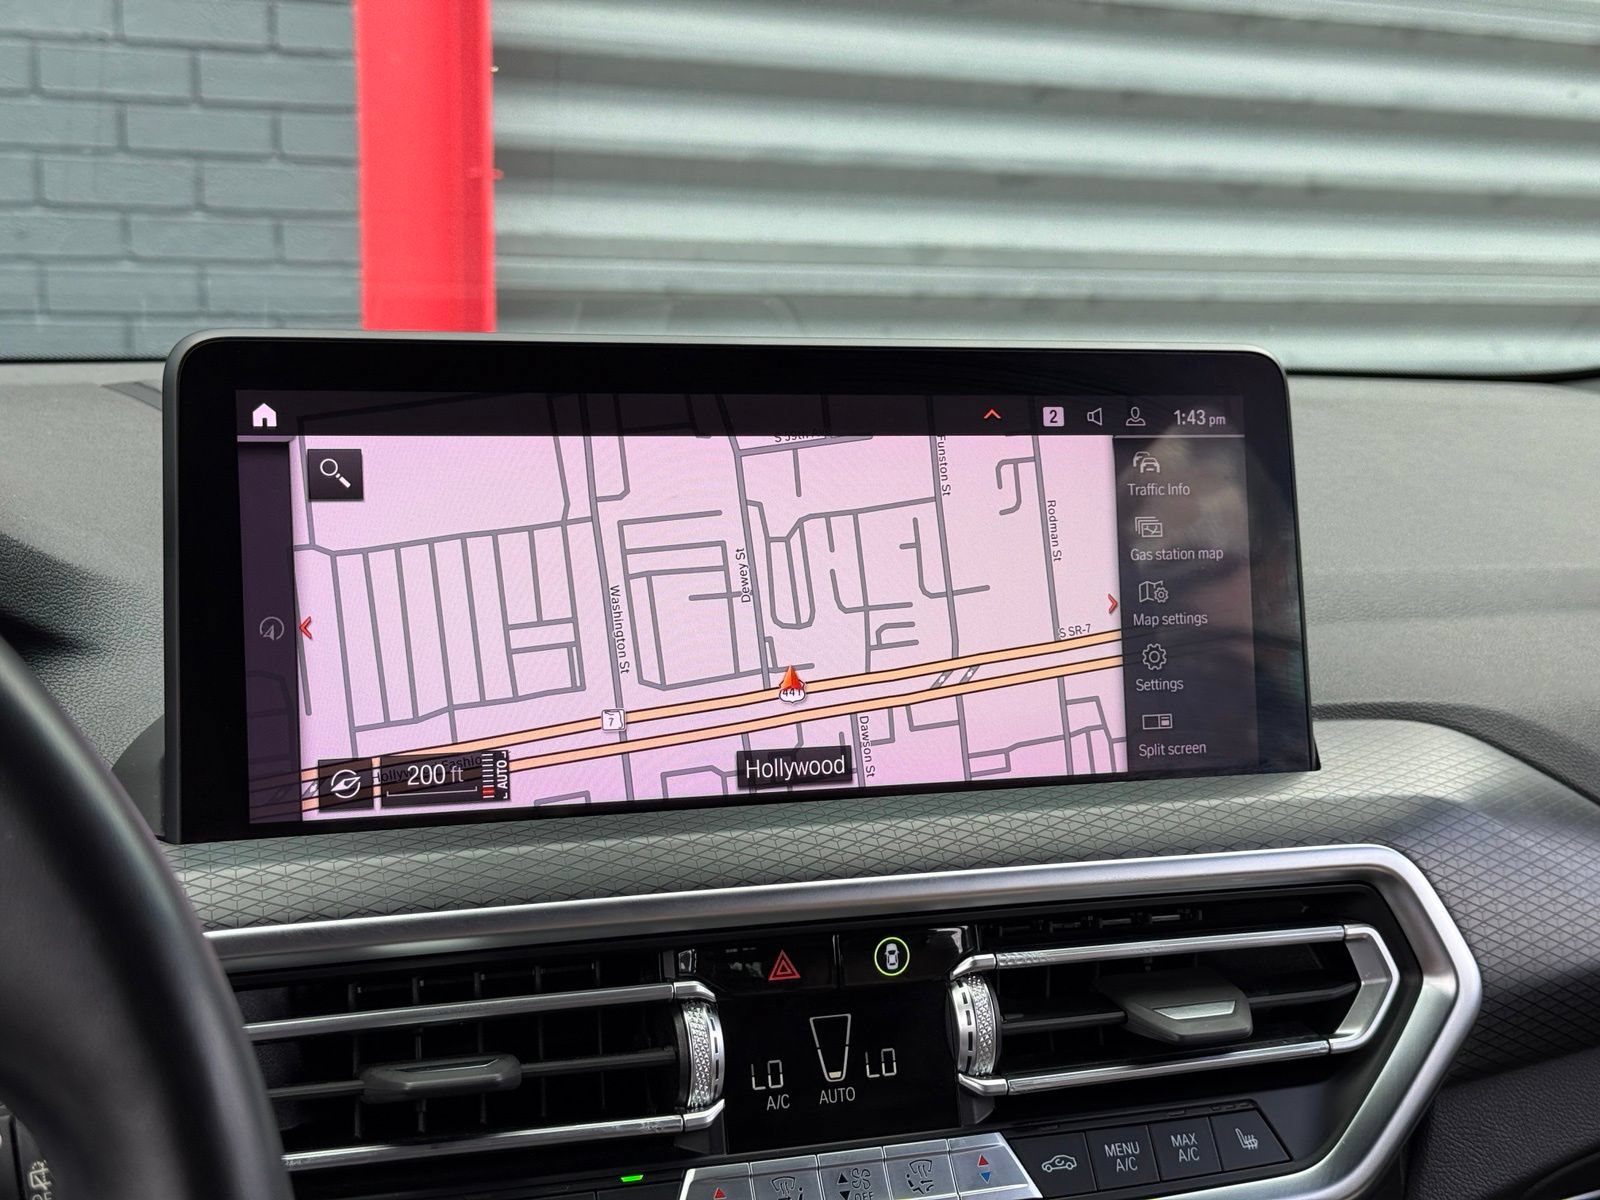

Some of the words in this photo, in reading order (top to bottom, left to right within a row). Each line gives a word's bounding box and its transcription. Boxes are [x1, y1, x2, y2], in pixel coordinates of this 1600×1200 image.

[1049, 409, 1058, 424] 2
[1173, 409, 1207, 426] 1:43
[1208, 414, 1227, 428] pm
[941, 484, 952, 497] St
[1127, 483, 1165, 497] Traffic
[1167, 482, 1191, 496] Info
[1047, 499, 1059, 547] Rodman
[735, 547, 746, 560] St
[1052, 549, 1062, 562] St
[1130, 547, 1154, 561] Gas
[1155, 547, 1195, 561] station
[1197, 549, 1224, 562] map
[740, 563, 751, 603] Dewey
[1132, 613, 1160, 628] Map
[1161, 611, 1209, 627] settings
[609, 584, 626, 659] Washington
[619, 661, 630, 674] St
[1059, 627, 1067, 638] S
[1068, 623, 1091, 637] SR-7
[1135, 678, 1184, 693] Settings
[608, 717, 615, 728] 7
[859, 715, 873, 763] Dawson
[1138, 743, 1166, 759] Split
[1167, 743, 1207, 755] screen
[407, 763, 446, 786] 200
[449, 765, 464, 784] ft
[496, 759, 509, 790] AUTO
[745, 754, 846, 781] Hollywood
[865, 765, 876, 778] St
[766, 1093, 791, 1112] A/C
[819, 1086, 856, 1105] AUTO
[1170, 1132, 1198, 1148] MAX
[1104, 1141, 1140, 1158] MENU
[1178, 1146, 1200, 1163] A/C
[1116, 1156, 1138, 1173] A/C
